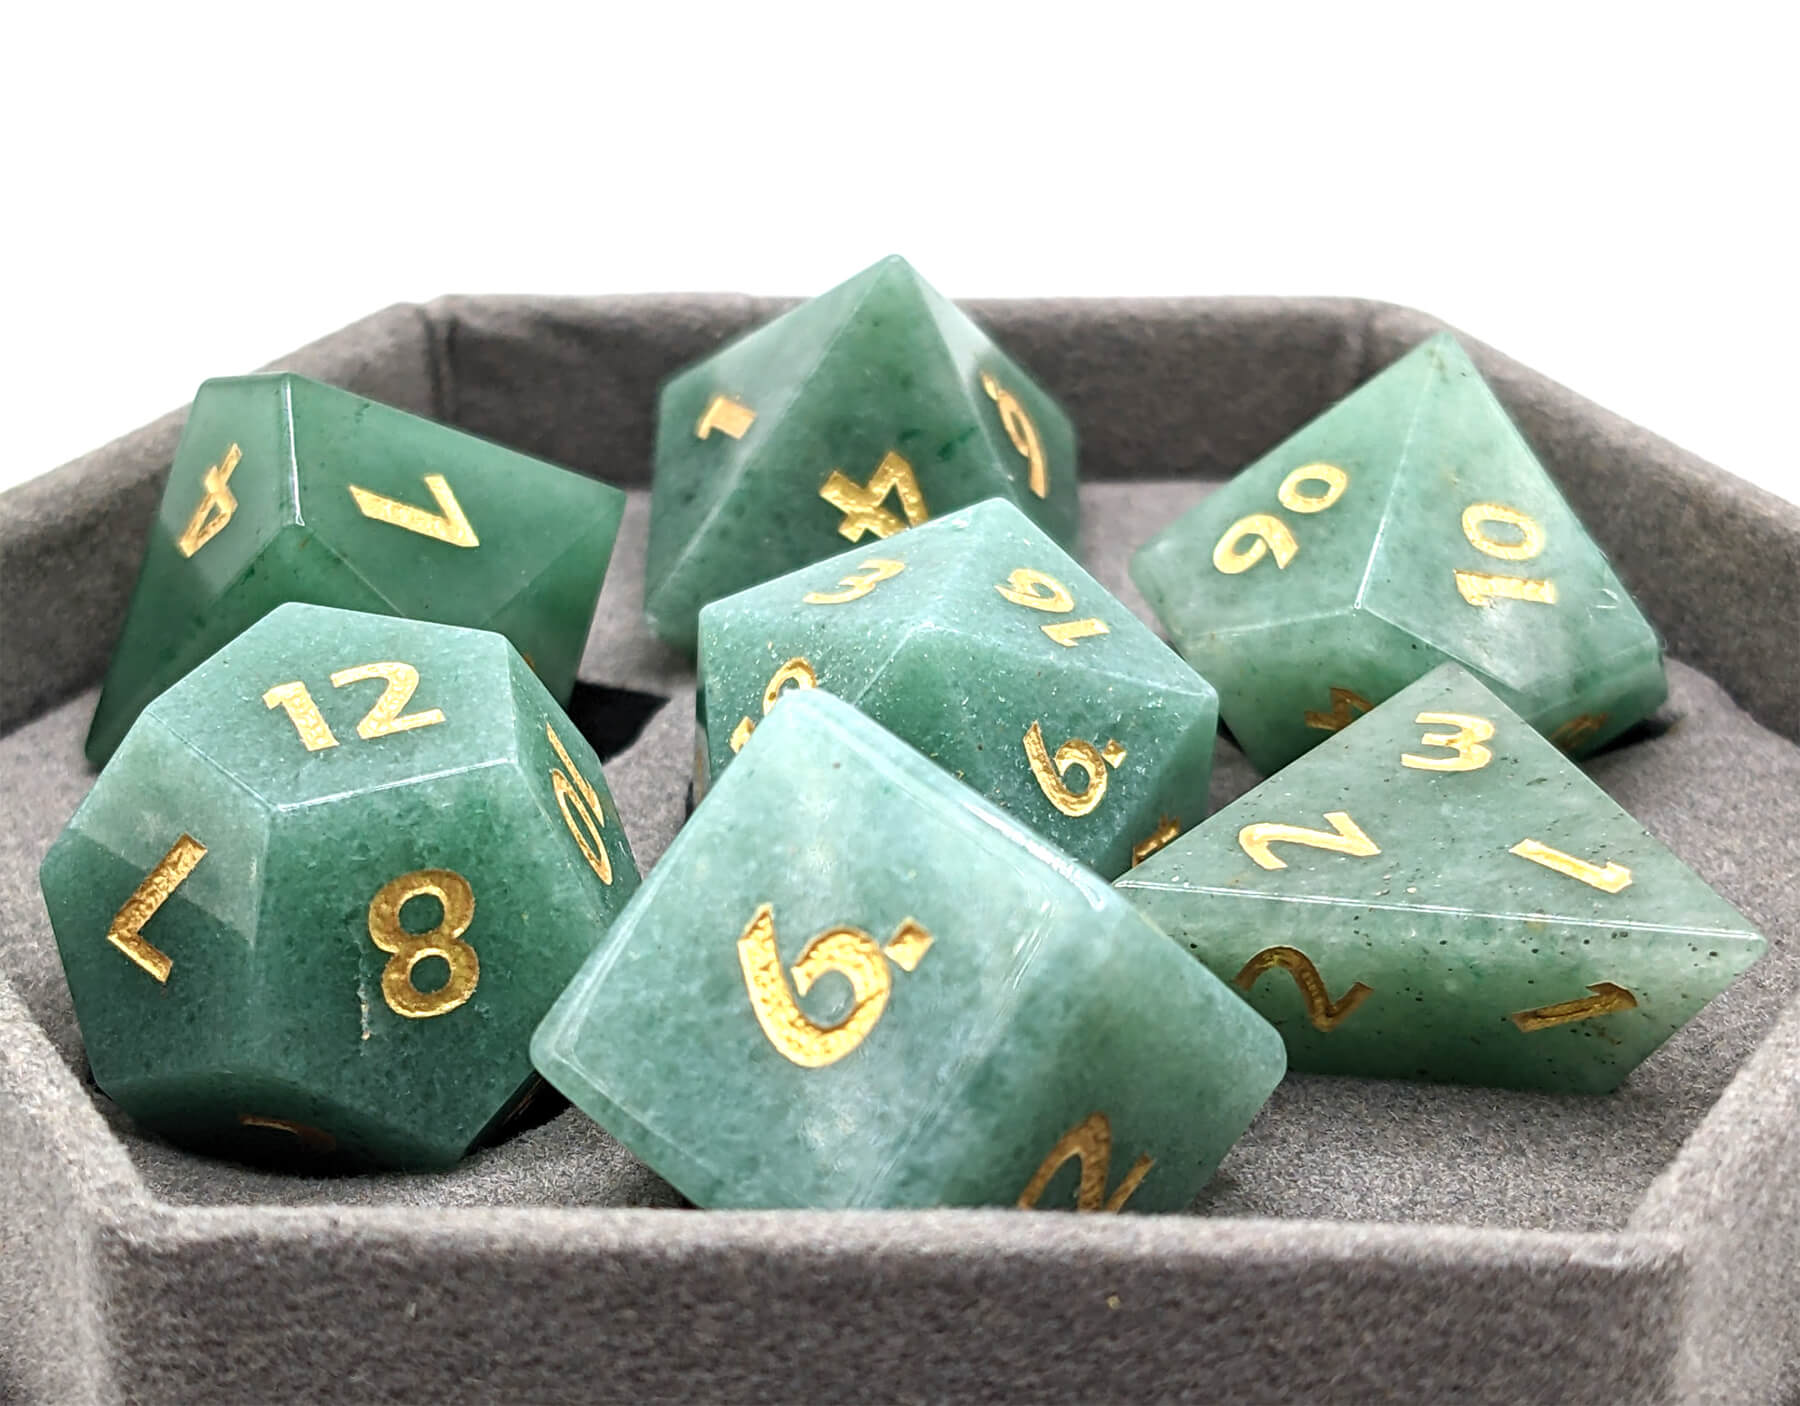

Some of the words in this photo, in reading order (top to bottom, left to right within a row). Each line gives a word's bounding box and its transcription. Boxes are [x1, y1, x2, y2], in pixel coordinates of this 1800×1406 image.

[695, 395, 758, 441] 1
[177, 442, 242, 558] 4
[348, 473, 480, 548] 7
[819, 449, 929, 543] 4
[1212, 462, 1349, 575] 90
[803, 558, 905, 605] 3
[1452, 503, 1557, 606] 10
[261, 661, 446, 752] 12
[1400, 712, 1496, 772] 3
[1237, 811, 1382, 871] 2
[1508, 837, 1634, 895] 1
[106, 832, 209, 984] 7
[368, 868, 480, 1019] 8
[1232, 944, 1375, 1033] 2
[1510, 981, 1639, 1034] 1
